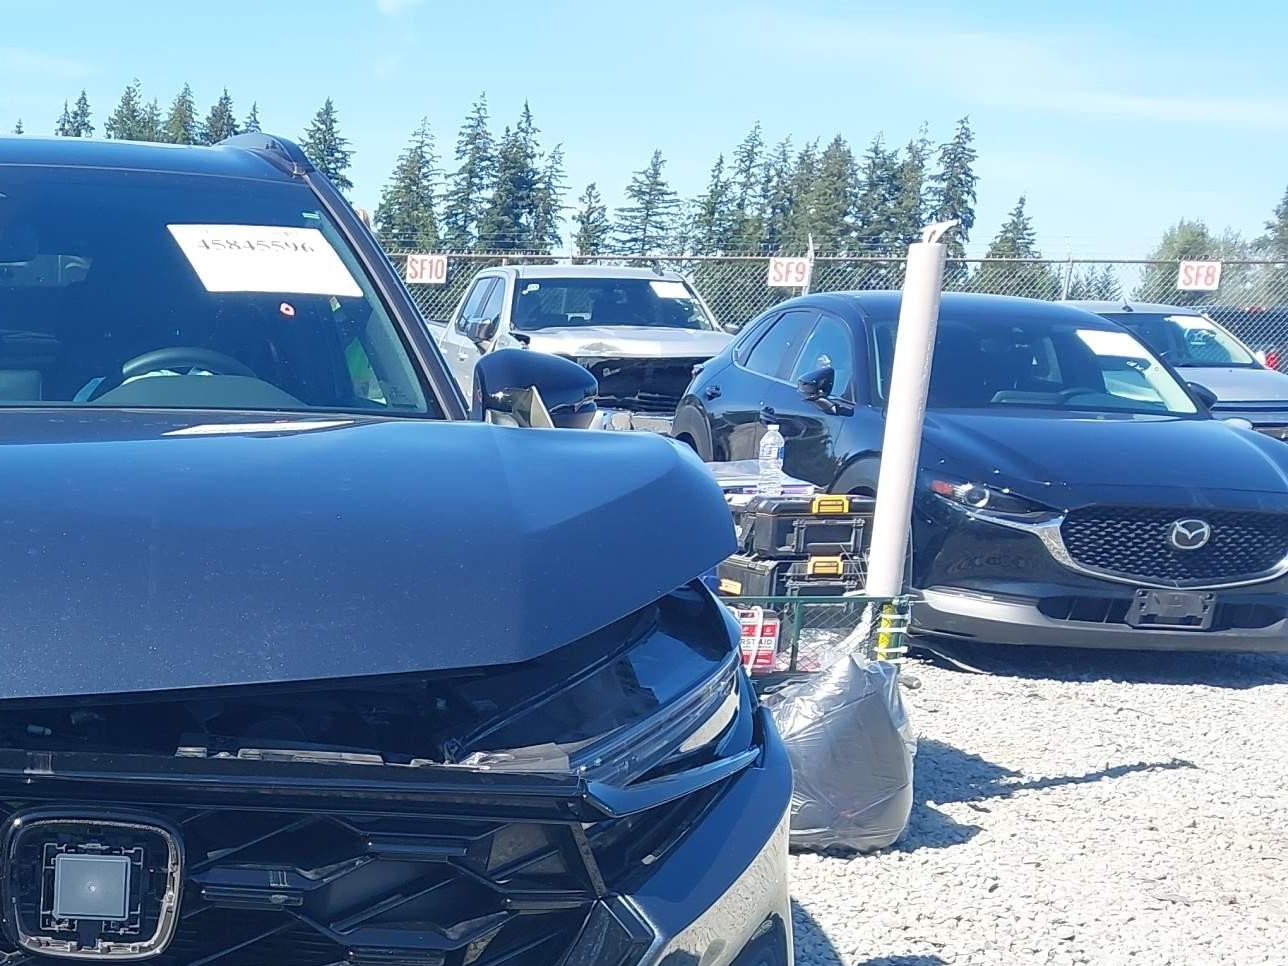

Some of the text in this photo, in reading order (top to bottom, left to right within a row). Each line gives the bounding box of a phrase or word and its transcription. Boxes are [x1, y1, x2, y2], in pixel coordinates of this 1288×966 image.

[409, 258, 445, 280] SF10
[773, 261, 806, 283] SF9
[1182, 265, 1217, 287] SF8
